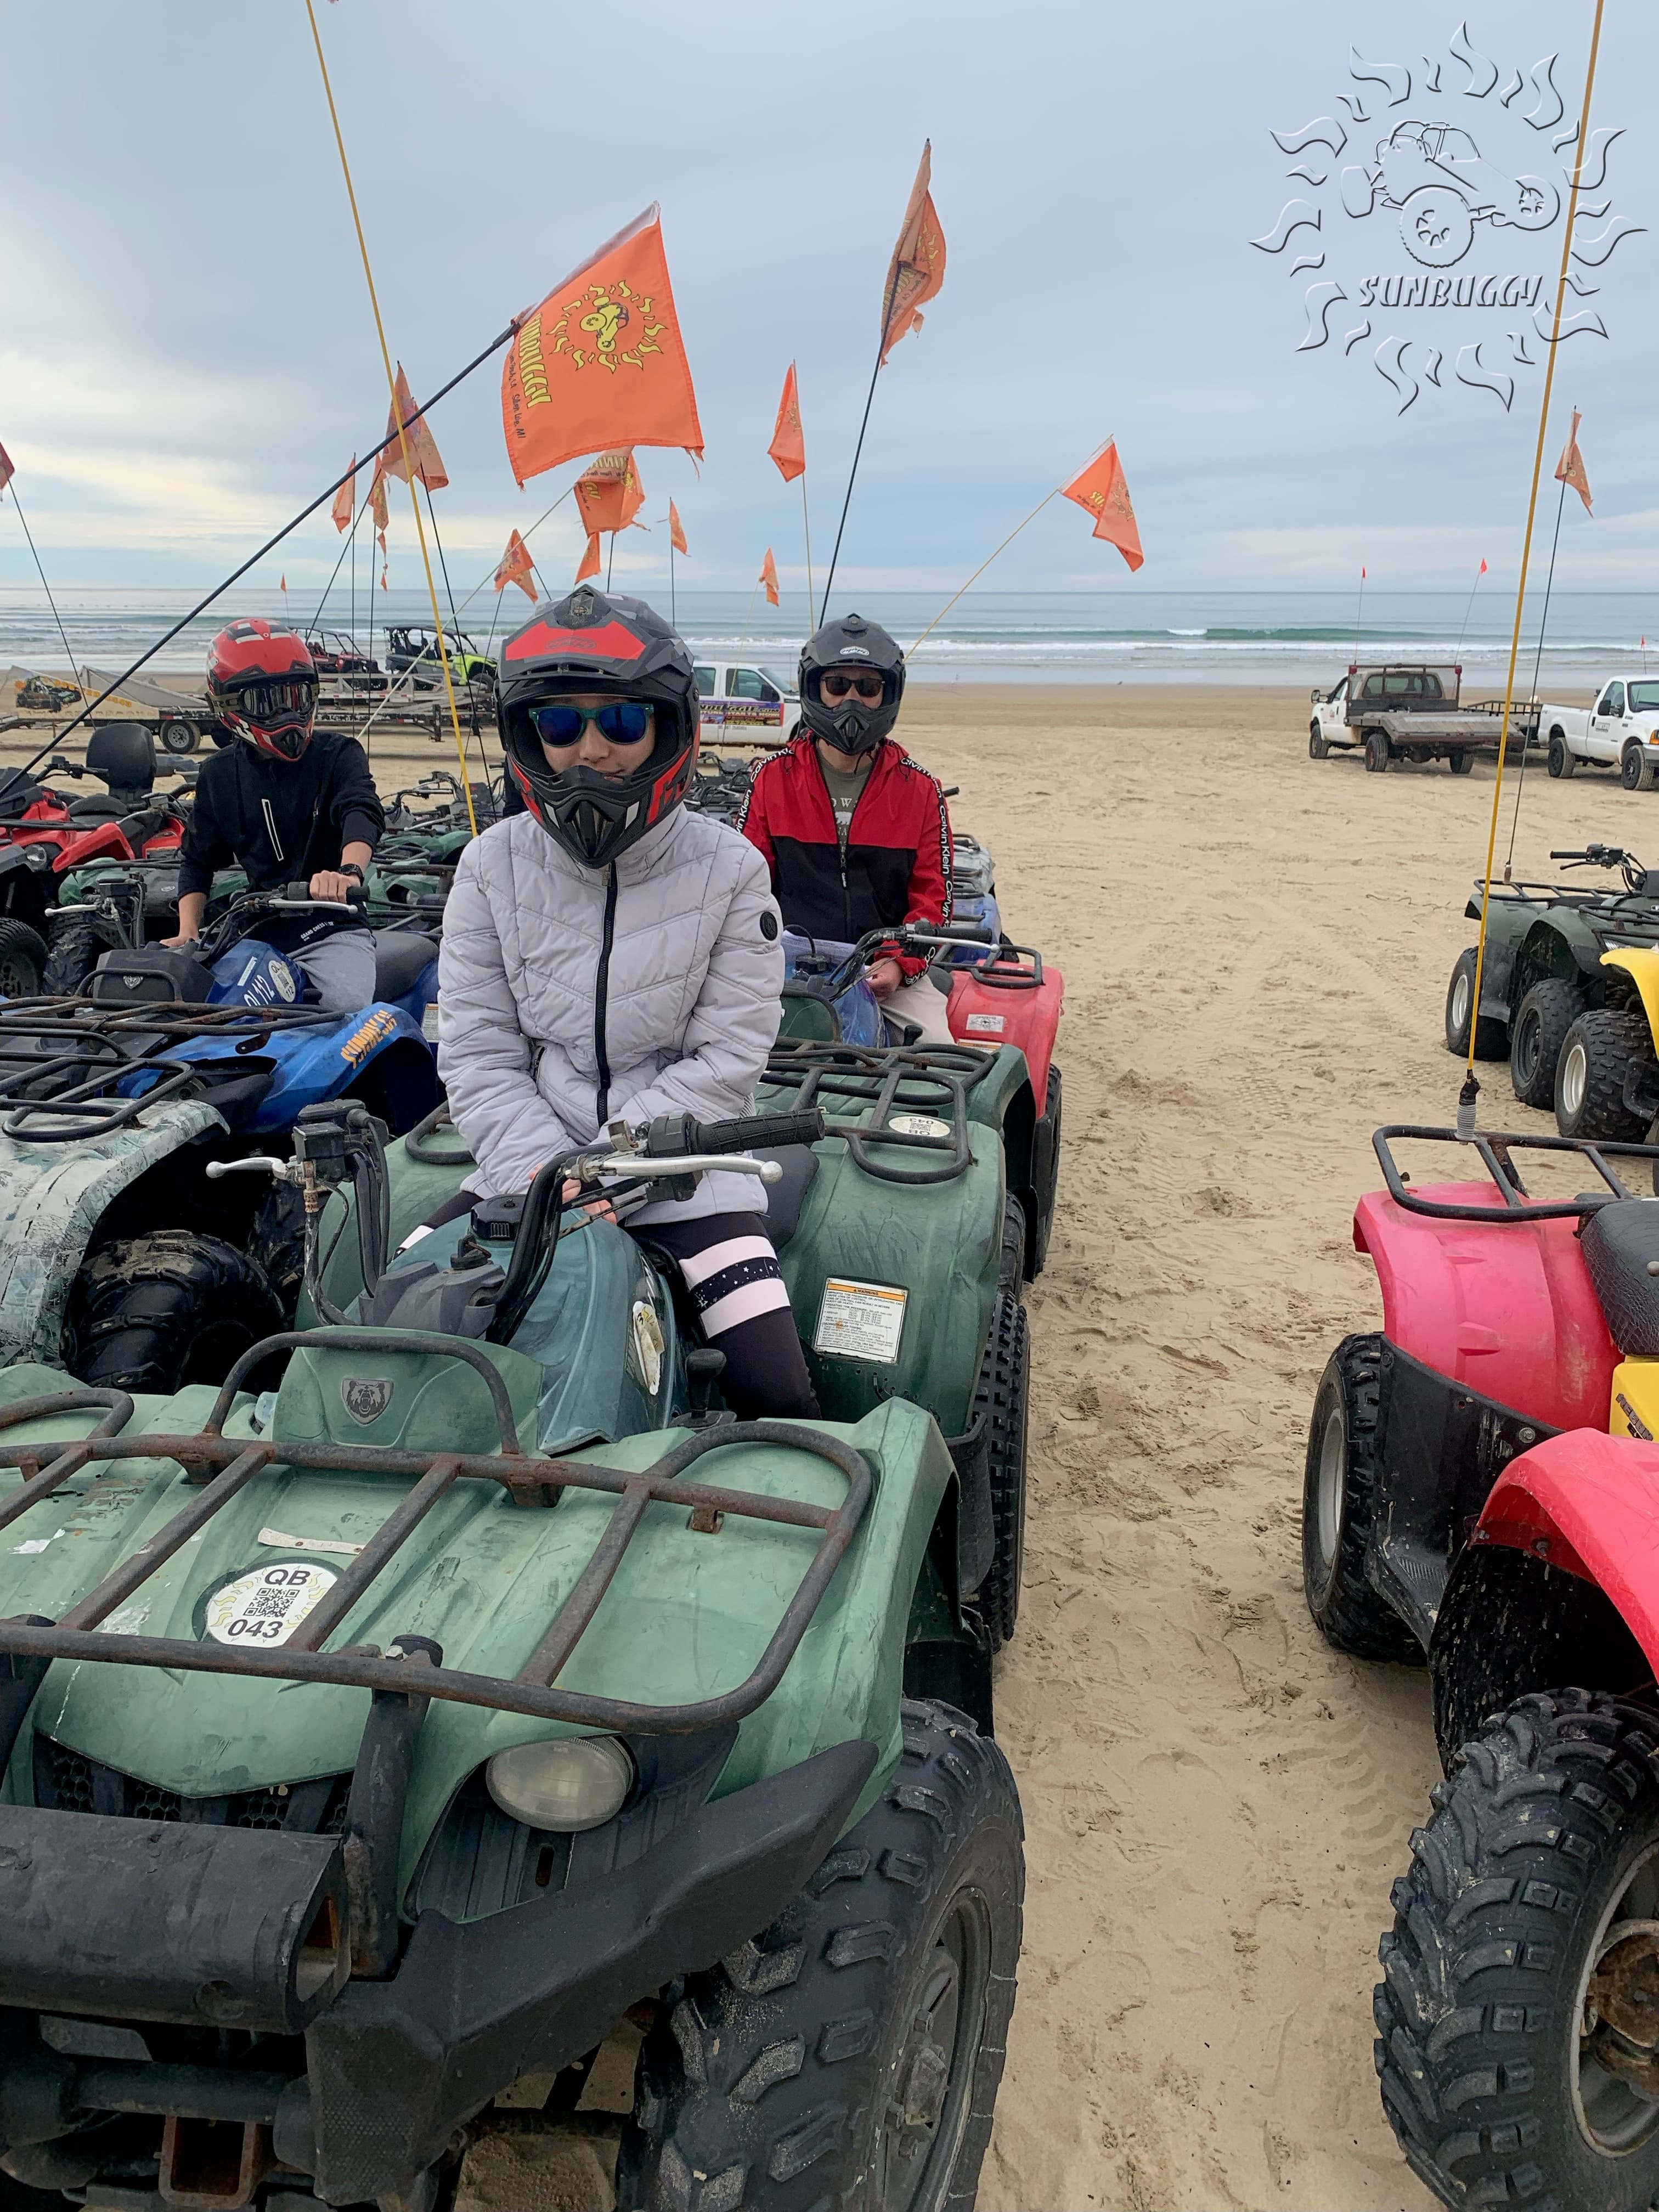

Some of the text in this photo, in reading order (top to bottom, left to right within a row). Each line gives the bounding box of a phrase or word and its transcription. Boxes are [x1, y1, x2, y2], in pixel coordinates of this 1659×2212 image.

[516, 428, 526, 438] MI
[751, 754, 777, 783] Calvin
[740, 789, 752, 818] Klein
[940, 805, 951, 874] Calvin Klein
[943, 881, 953, 917] Calvin
[300, 929, 314, 939] GRAND
[252, 975, 275, 1006] 112
[286, 985, 295, 998] 112
[264, 1568, 311, 1585] QB
[228, 1619, 284, 1639] 043
